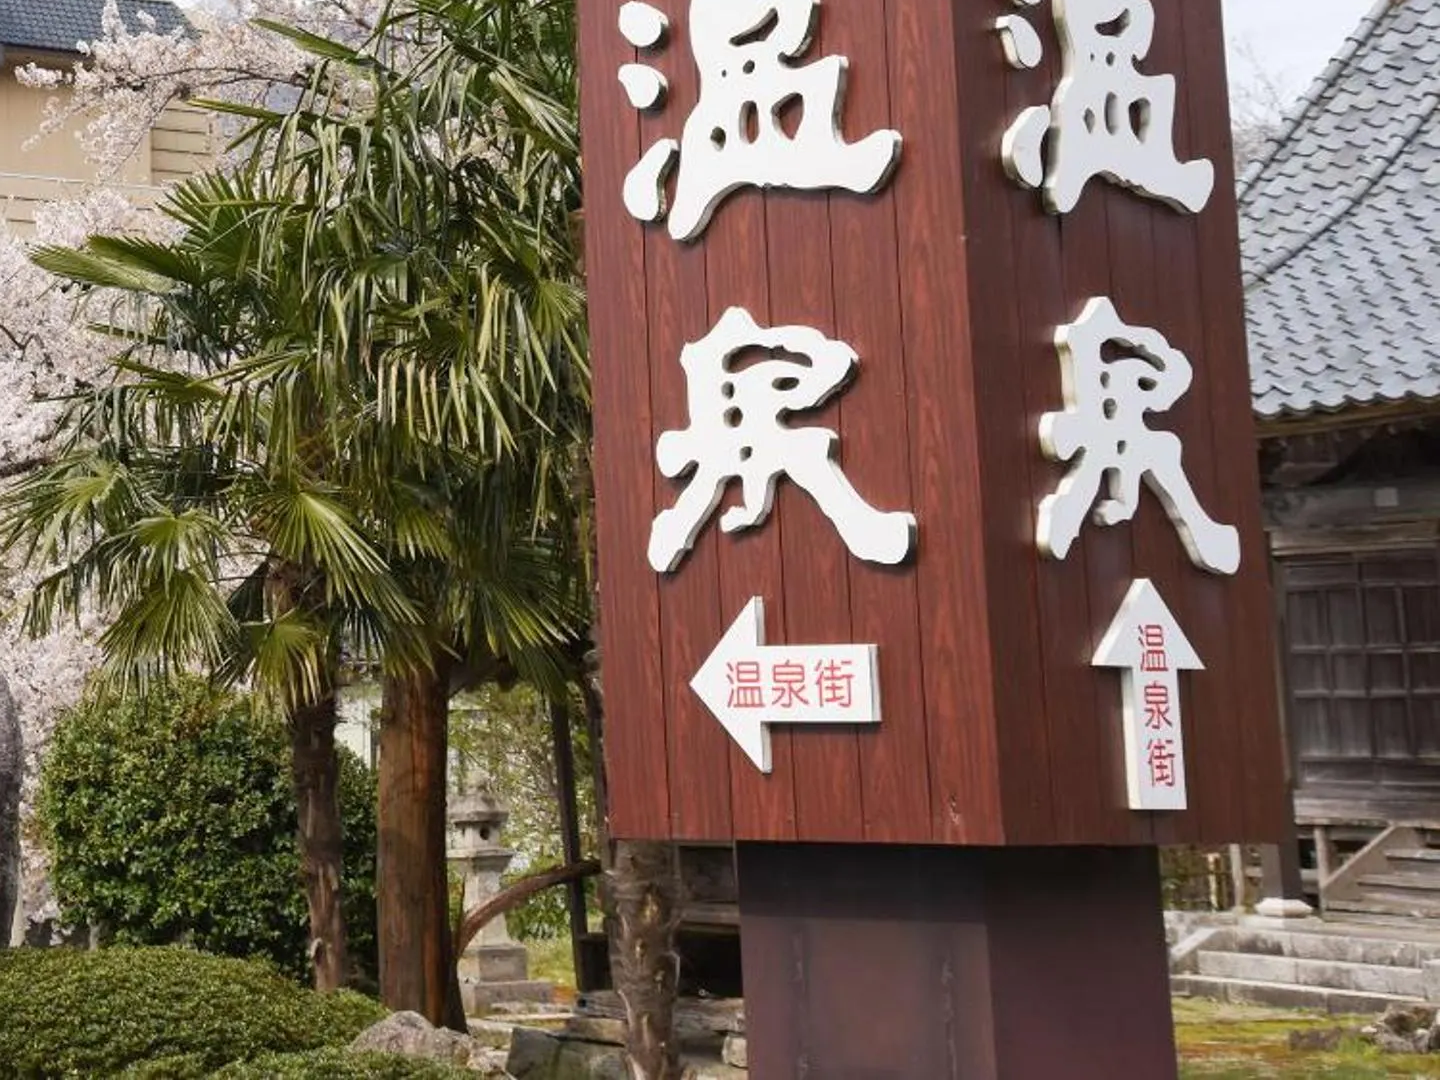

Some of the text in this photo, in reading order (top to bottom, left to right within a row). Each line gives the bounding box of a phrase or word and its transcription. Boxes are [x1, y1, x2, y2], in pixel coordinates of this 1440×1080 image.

[725, 659, 854, 709] 温泉街
[1137, 624, 1176, 788] 温泉街
